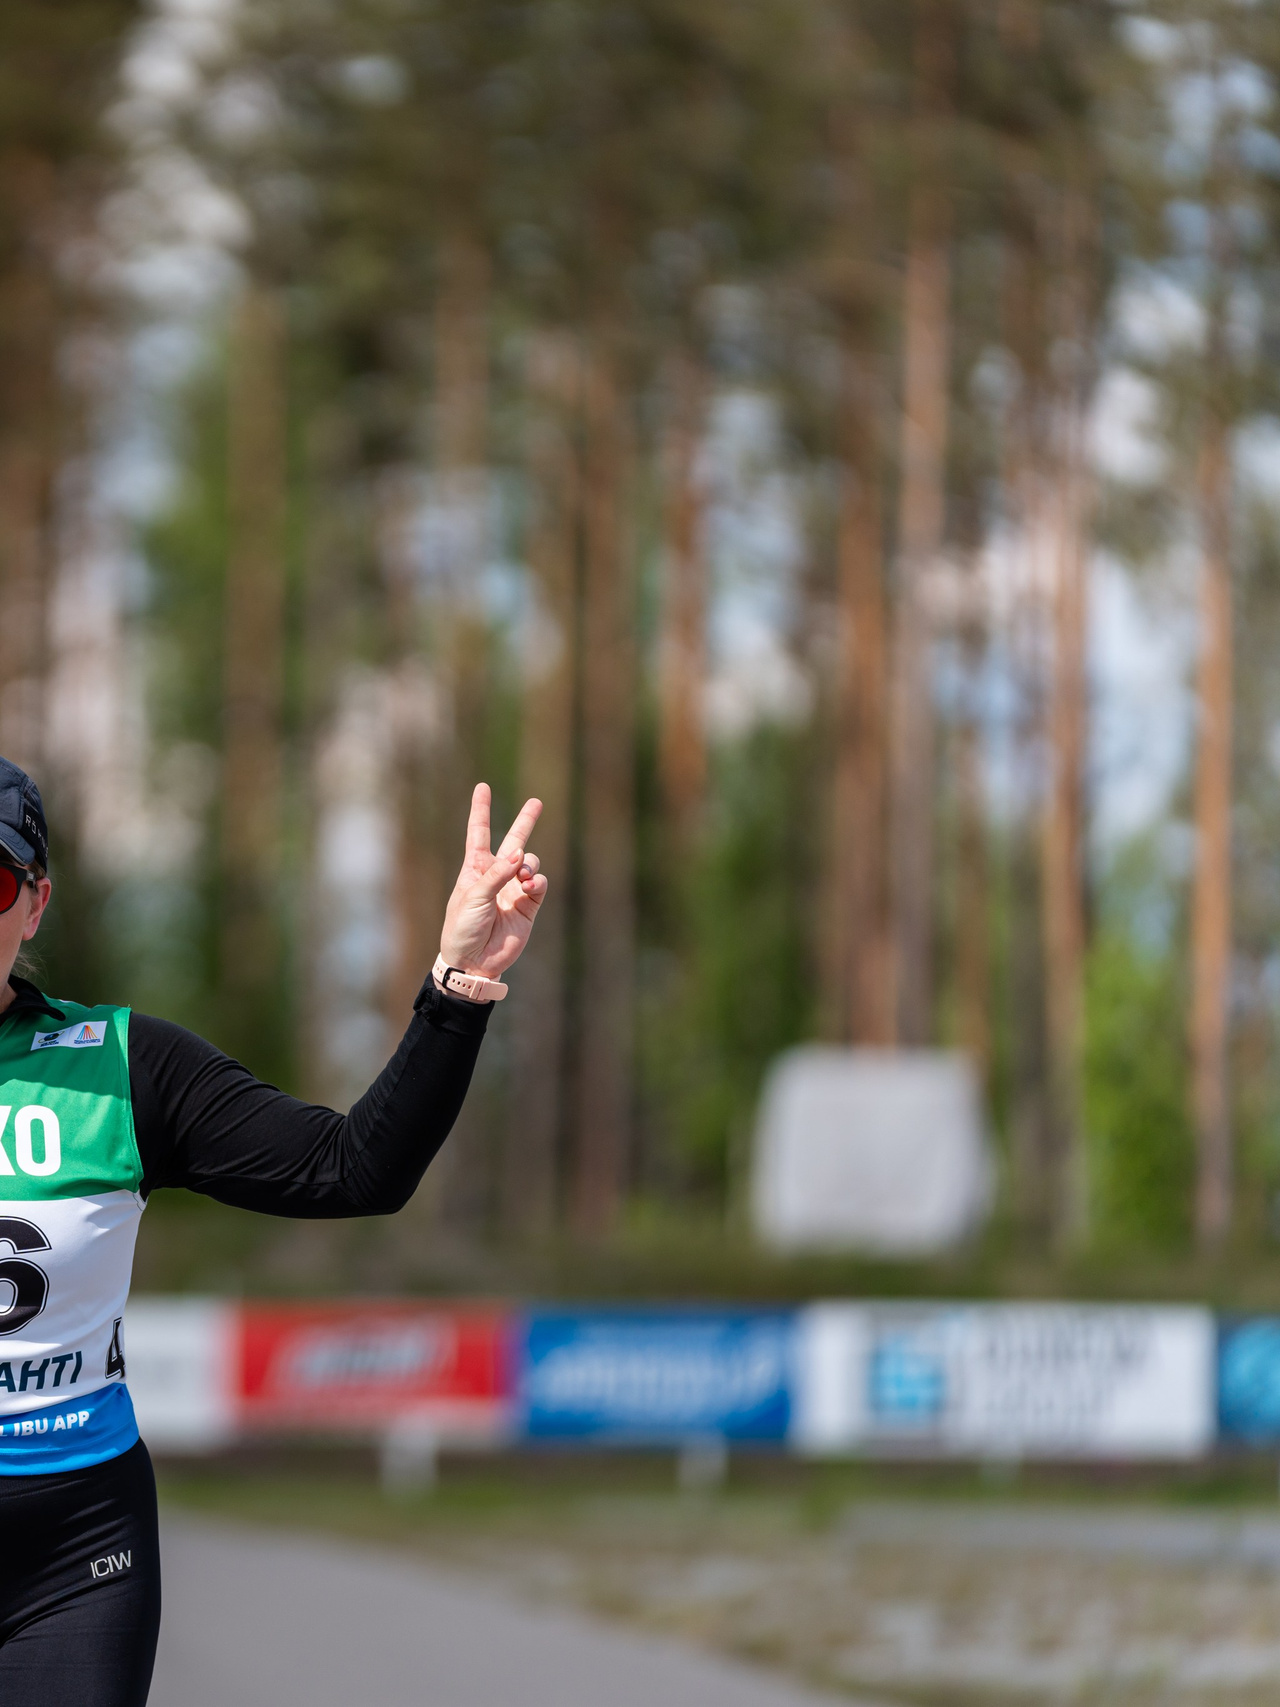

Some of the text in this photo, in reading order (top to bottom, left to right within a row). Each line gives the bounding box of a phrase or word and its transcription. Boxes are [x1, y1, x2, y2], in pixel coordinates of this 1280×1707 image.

[13, 1417, 49, 1437] IBU
[52, 1410, 90, 1432] APP
[90, 1550, 131, 1579] ICIW
